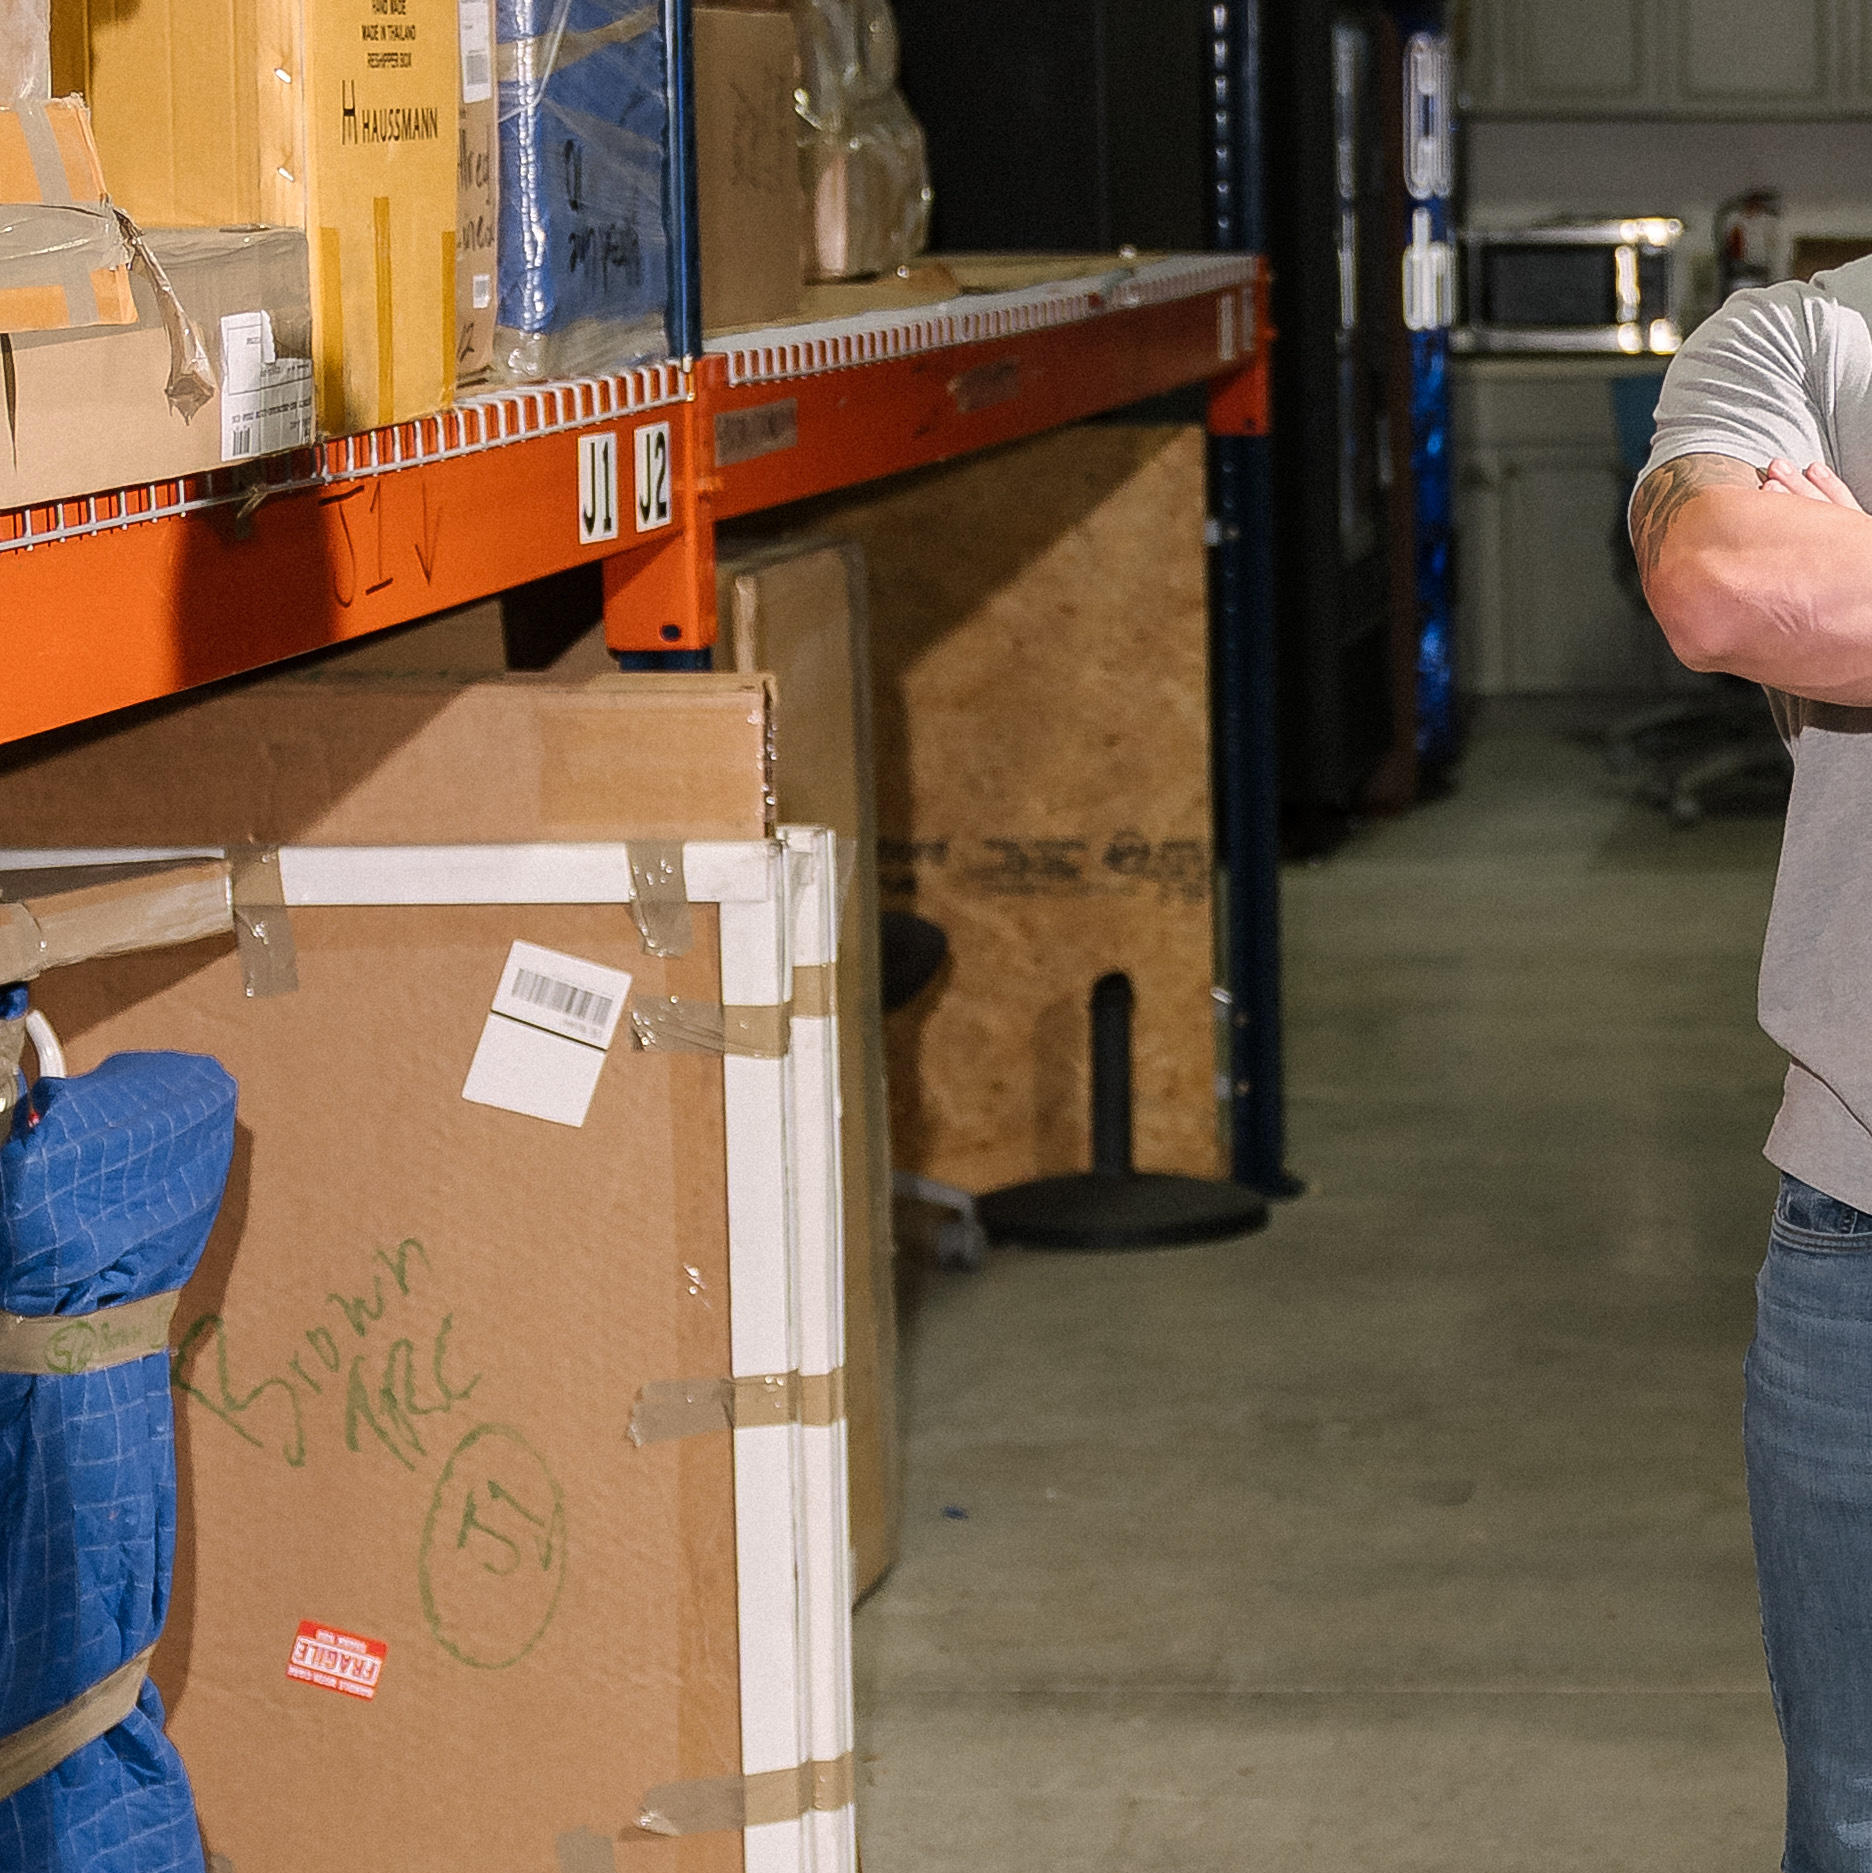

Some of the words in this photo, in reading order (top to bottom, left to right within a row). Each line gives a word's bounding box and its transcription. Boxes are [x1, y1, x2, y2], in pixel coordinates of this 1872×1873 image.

[361, 24, 379, 42] MADE
[379, 24, 387, 41] IN
[387, 23, 417, 42] THAILAND
[361, 107, 440, 145] HAUSSMANN
[582, 440, 613, 539] J1
[639, 430, 668, 526] J2
[170, 1237, 432, 1468] Brown
[456, 1480, 553, 1576] J1
[295, 1638, 379, 1683] FRAGILE
